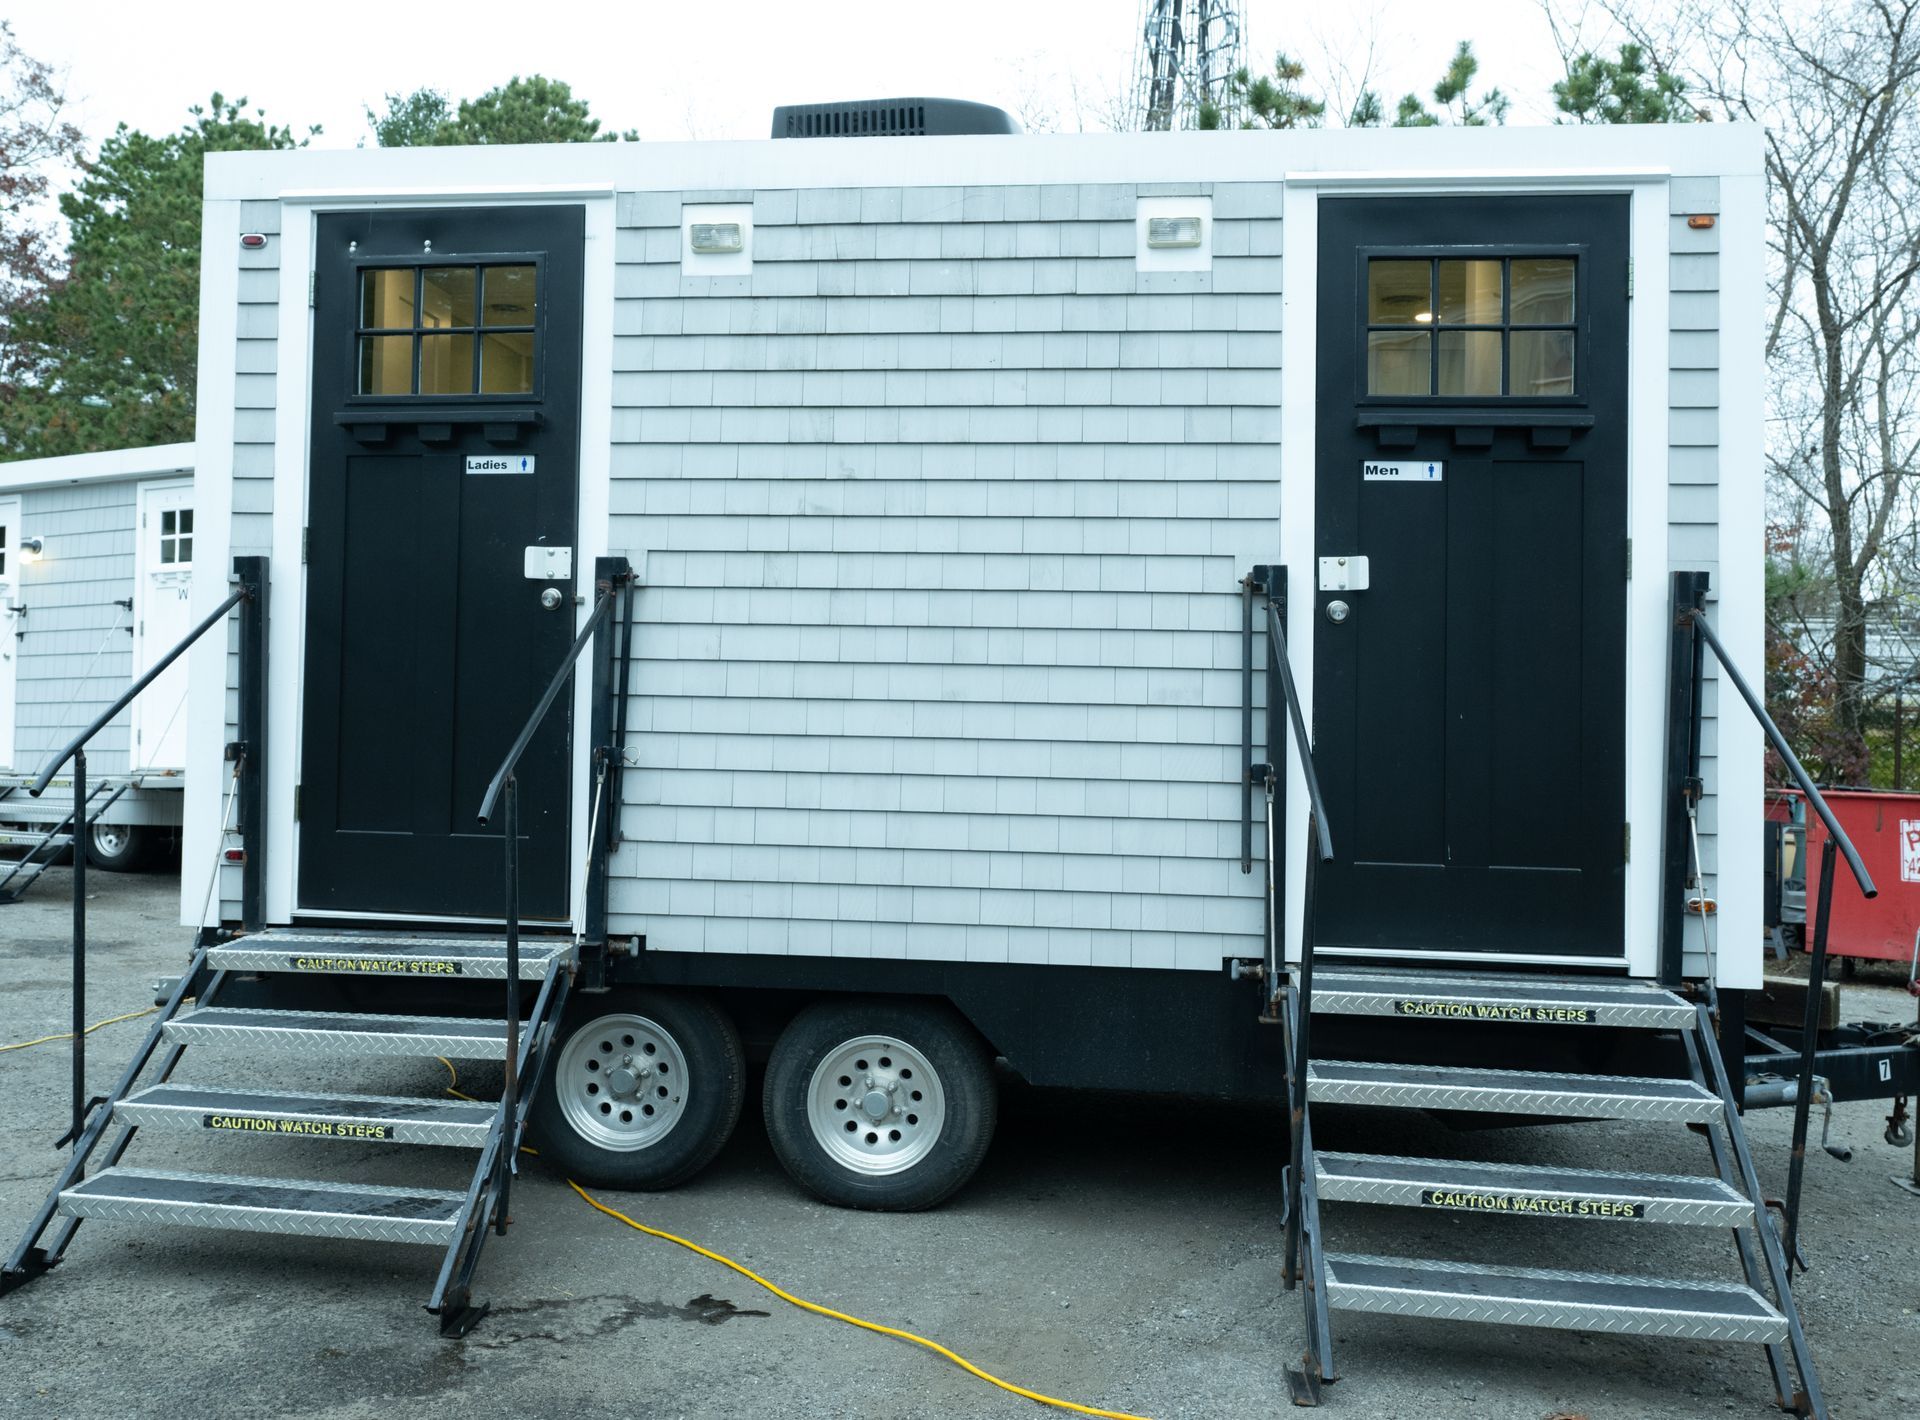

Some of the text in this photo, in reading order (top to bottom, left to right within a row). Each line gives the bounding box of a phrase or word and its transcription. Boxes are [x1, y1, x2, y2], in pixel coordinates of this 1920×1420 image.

[468, 460, 508, 470] Ladies
[1366, 466, 1398, 475] Men
[360, 960, 410, 973] WATCH
[410, 961, 455, 974] STEPS
[1404, 1002, 1587, 1022] CAUTION WATCH STEPS
[1881, 1062, 1888, 1078] 7
[212, 1116, 385, 1138] CAUTION WATCH STEPS
[1432, 1192, 1634, 1216] CAUTION WATCH STEPS
